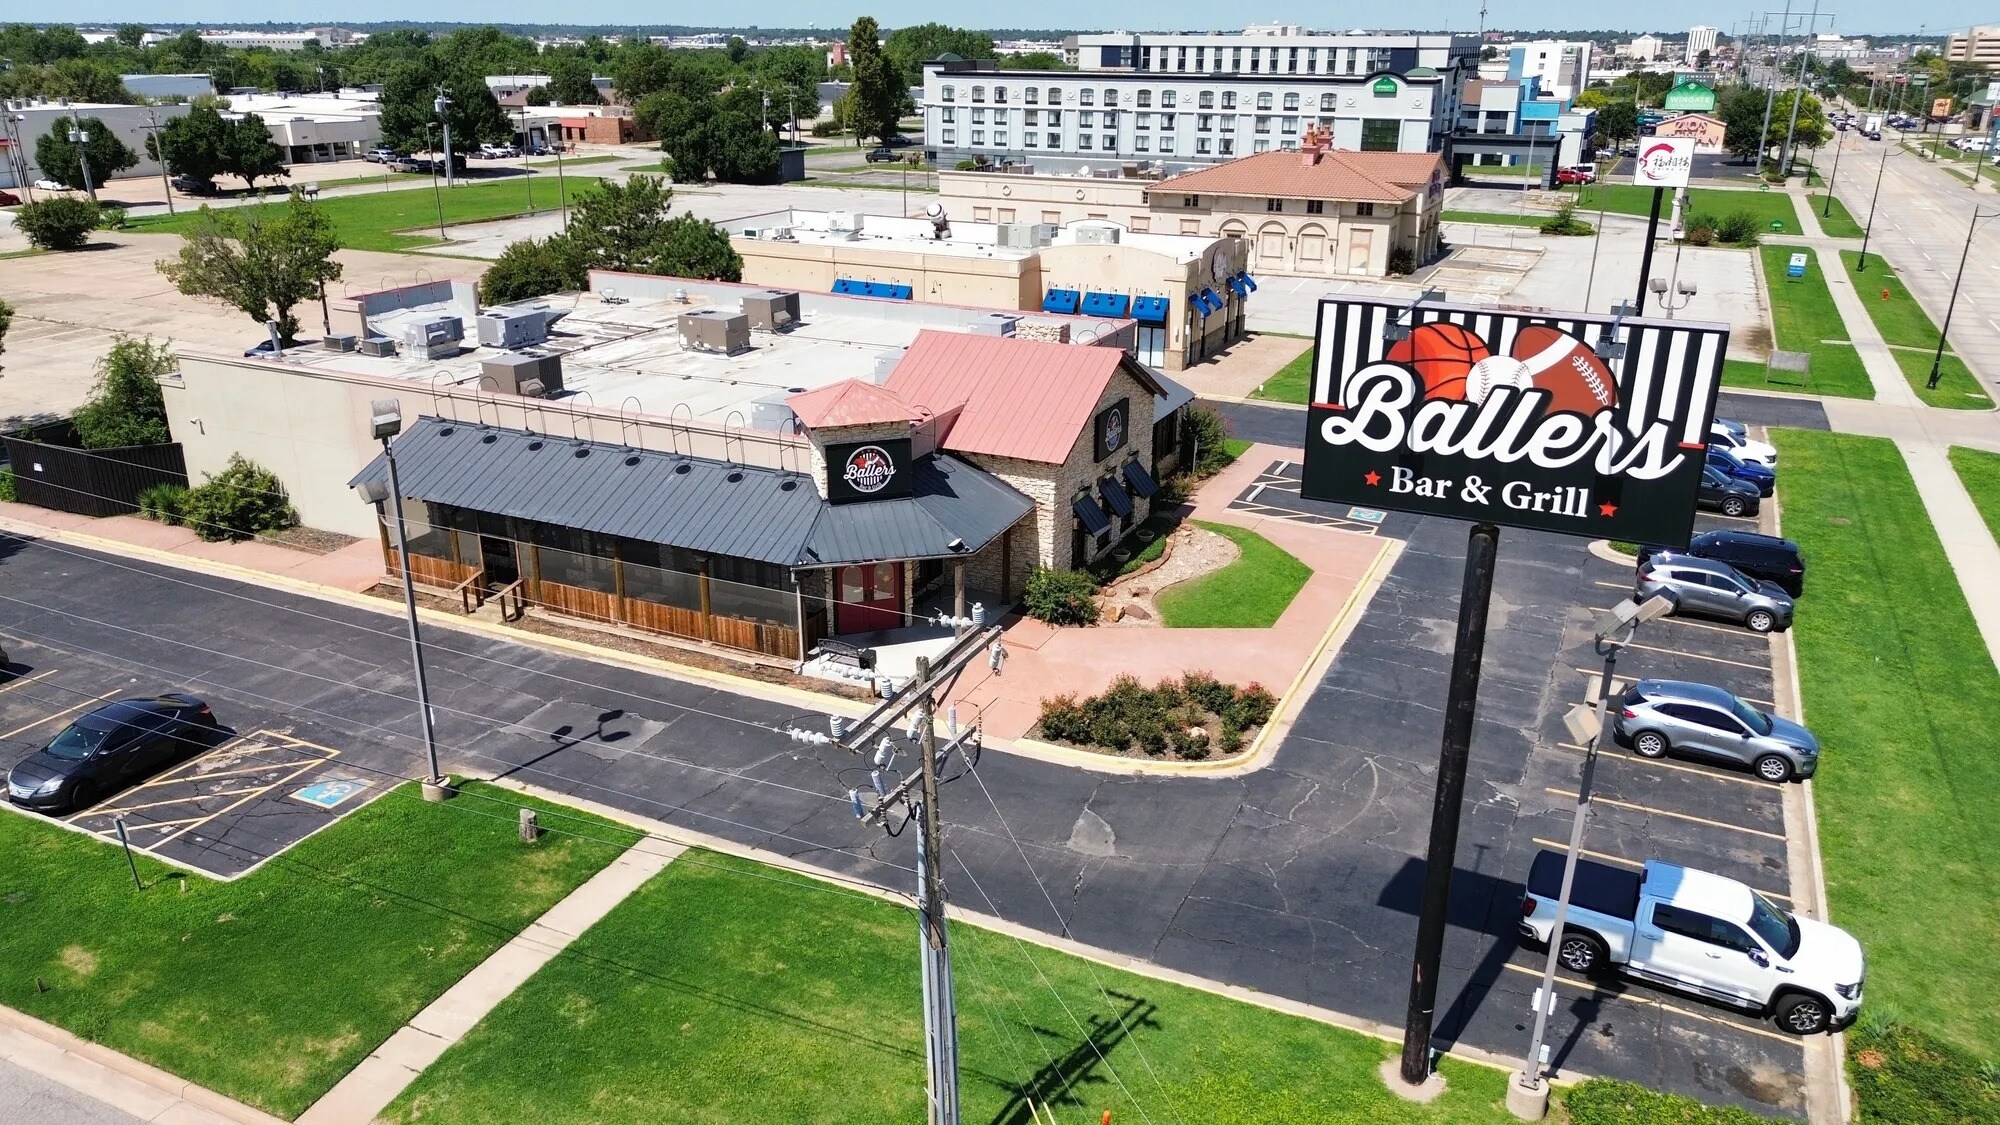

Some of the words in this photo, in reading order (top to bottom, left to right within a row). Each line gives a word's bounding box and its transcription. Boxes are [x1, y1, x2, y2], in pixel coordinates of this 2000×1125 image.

[1670, 96, 1711, 104] WINGATE
[1320, 363, 1685, 480] Ballers
[843, 464, 896, 480] Ballers
[1388, 466, 1452, 499] Bar
[1460, 475, 1492, 505] &
[1501, 480, 1589, 518] Grill
